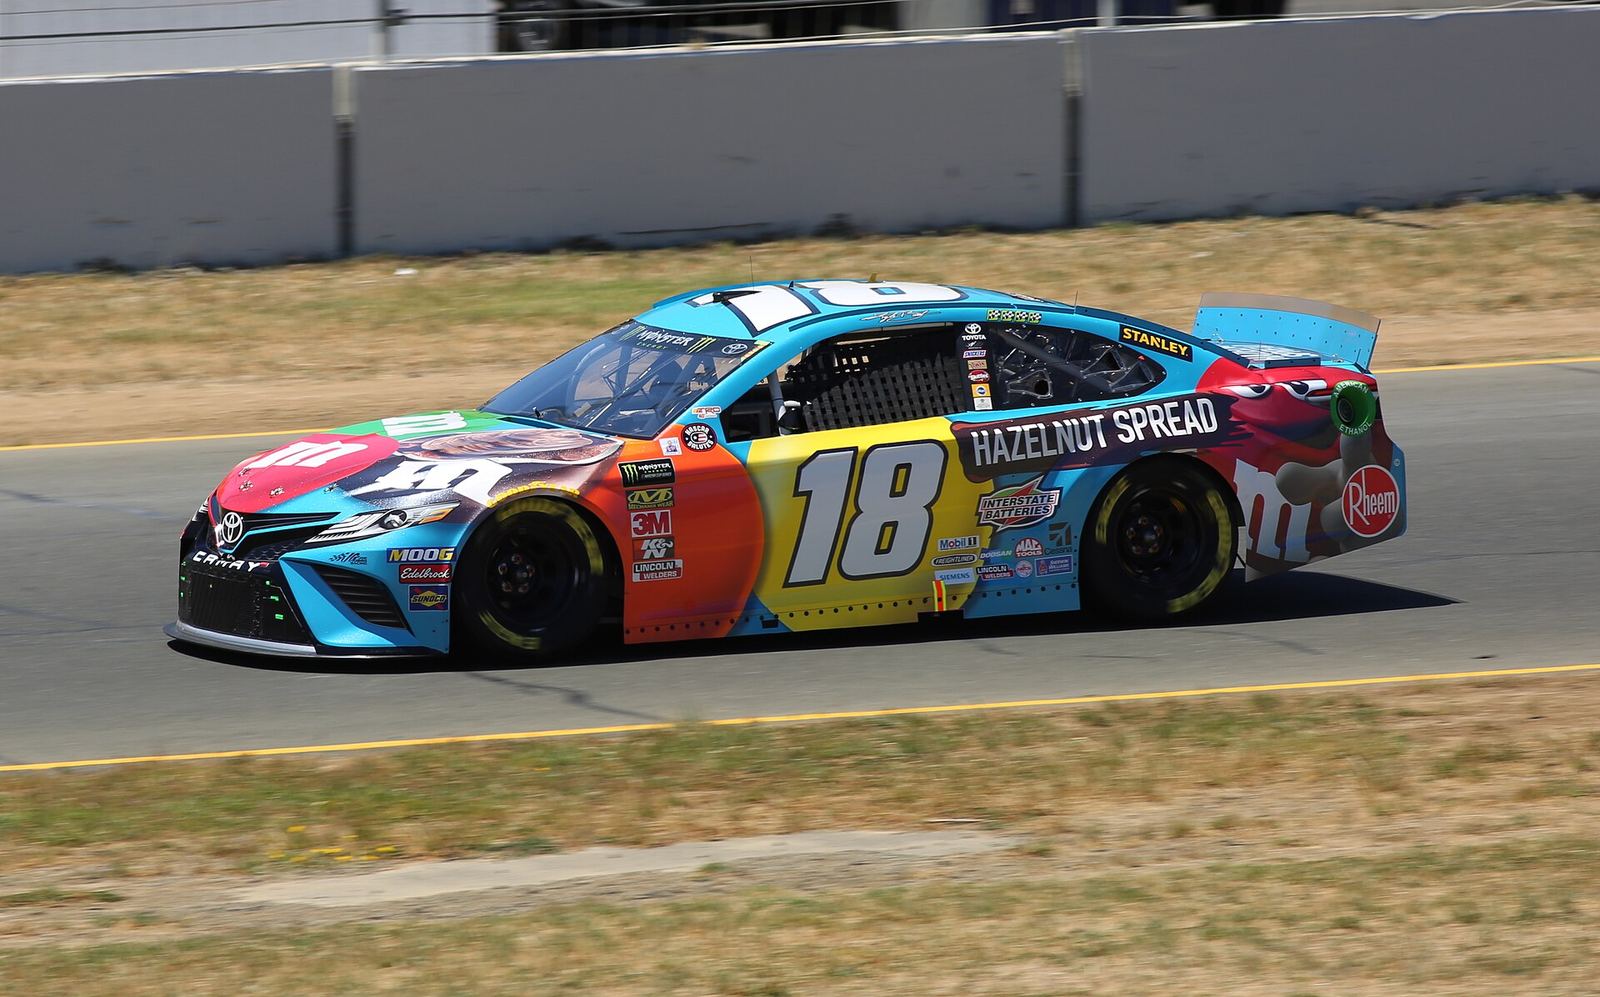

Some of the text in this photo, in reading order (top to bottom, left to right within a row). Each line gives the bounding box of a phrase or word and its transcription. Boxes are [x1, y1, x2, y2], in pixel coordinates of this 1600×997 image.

[636, 329, 694, 347] MONSTER
[1121, 327, 1189, 357] STANLEY
[685, 425, 710, 436] NASCAR
[971, 398, 1218, 467] HAZELNUT SPREAD
[1340, 422, 1371, 436] ETHANOL
[687, 439, 714, 450] SALUTES
[638, 462, 671, 471] MONSTER
[983, 494, 1055, 508] INTERSTATE
[1349, 469, 1396, 527] Rheem
[783, 439, 948, 588] 18
[985, 505, 1050, 520] BATTERIES
[633, 511, 670, 536] 3M
[940, 537, 977, 549] Mobil 1
[1016, 539, 1042, 552] MAC
[389, 548, 454, 562] MOOG
[935, 555, 974, 565] FREIGHTLINER
[980, 550, 1012, 559] DOOSAN
[400, 567, 450, 579] Edelbrock
[635, 562, 674, 573] LINCOLN
[977, 565, 1007, 574] LINCOLN
[643, 570, 677, 579] WELDERS
[939, 571, 970, 580] SIEMENS
[411, 595, 447, 603] SUNOCO
